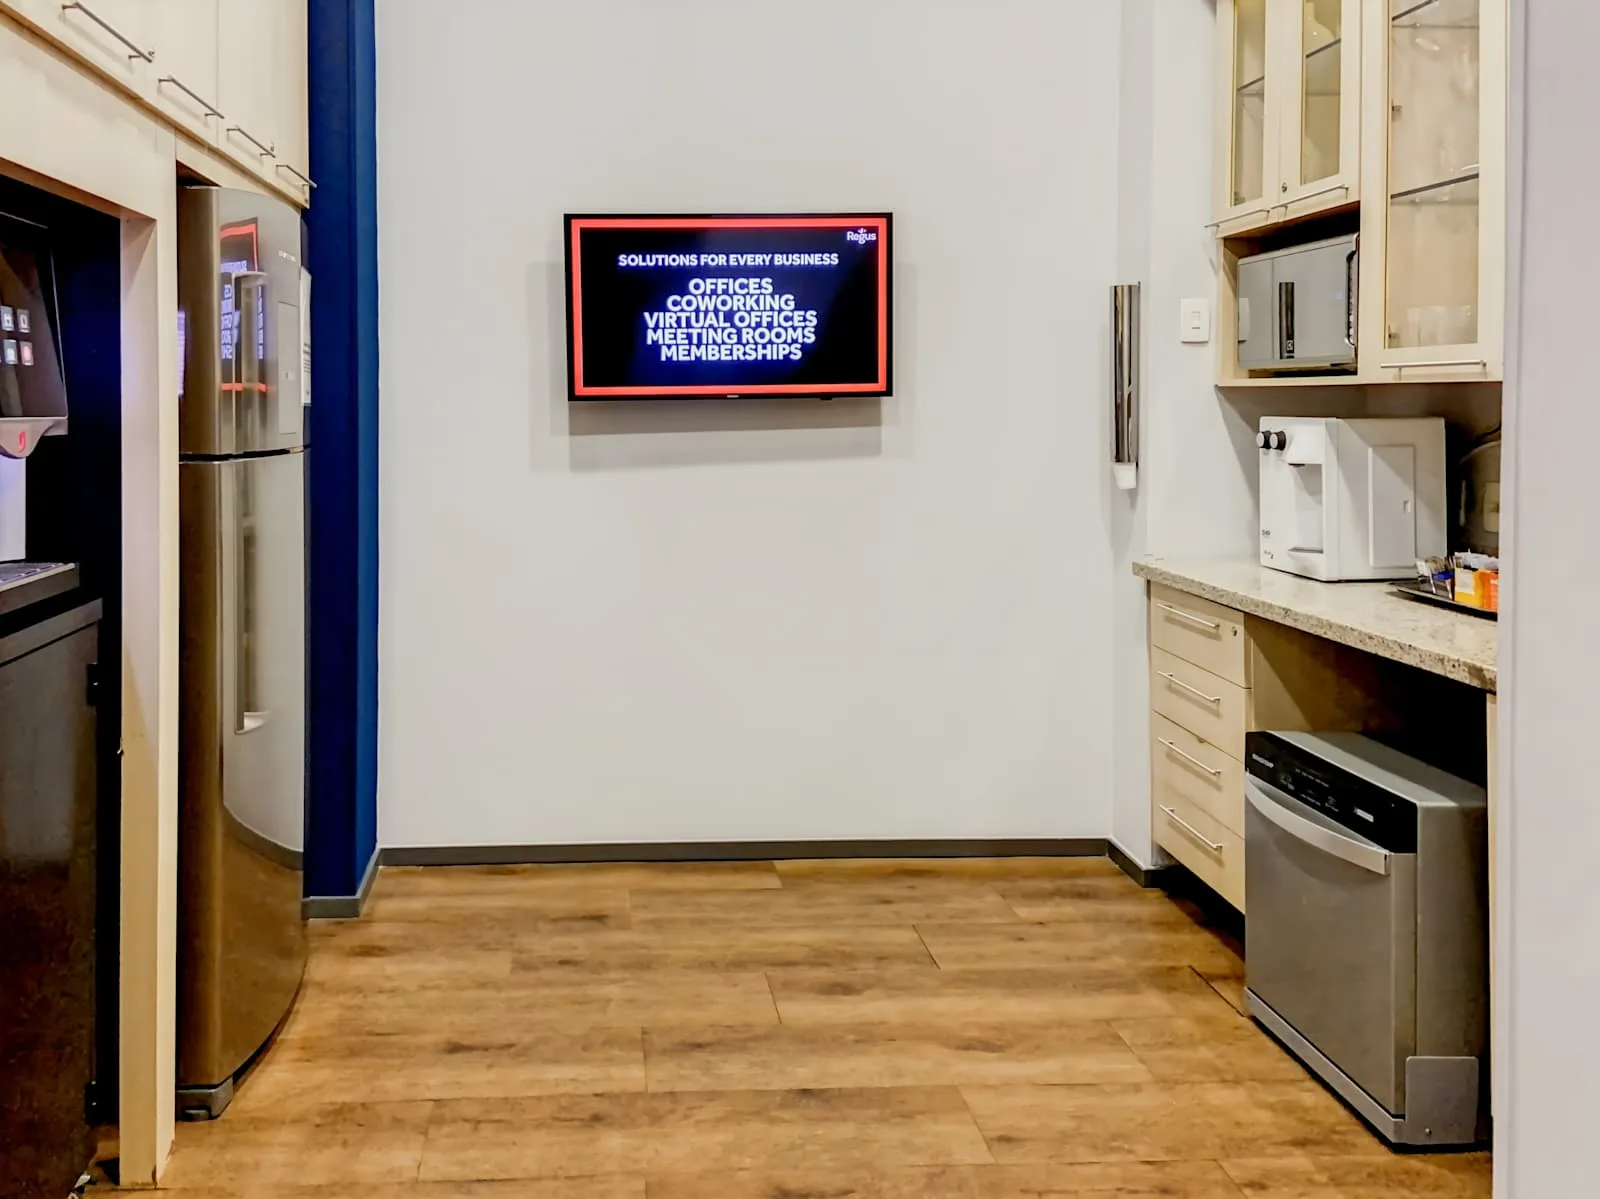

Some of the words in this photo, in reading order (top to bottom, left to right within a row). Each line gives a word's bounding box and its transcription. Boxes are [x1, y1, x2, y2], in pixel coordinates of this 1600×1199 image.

[846, 231, 876, 244] Regus
[618, 254, 698, 266] SOLUTIONS
[700, 254, 728, 266] FOR
[729, 253, 772, 266] EVERY
[774, 253, 839, 266] BUSINESS
[688, 278, 773, 295] OFFICES
[666, 294, 795, 312] COWORKING
[643, 312, 730, 329] VIRTUAL
[733, 310, 817, 328] OFFICES
[646, 328, 738, 345] MEETING
[741, 327, 816, 344] ROOMS
[660, 344, 802, 361] MEMBERSHIPS
